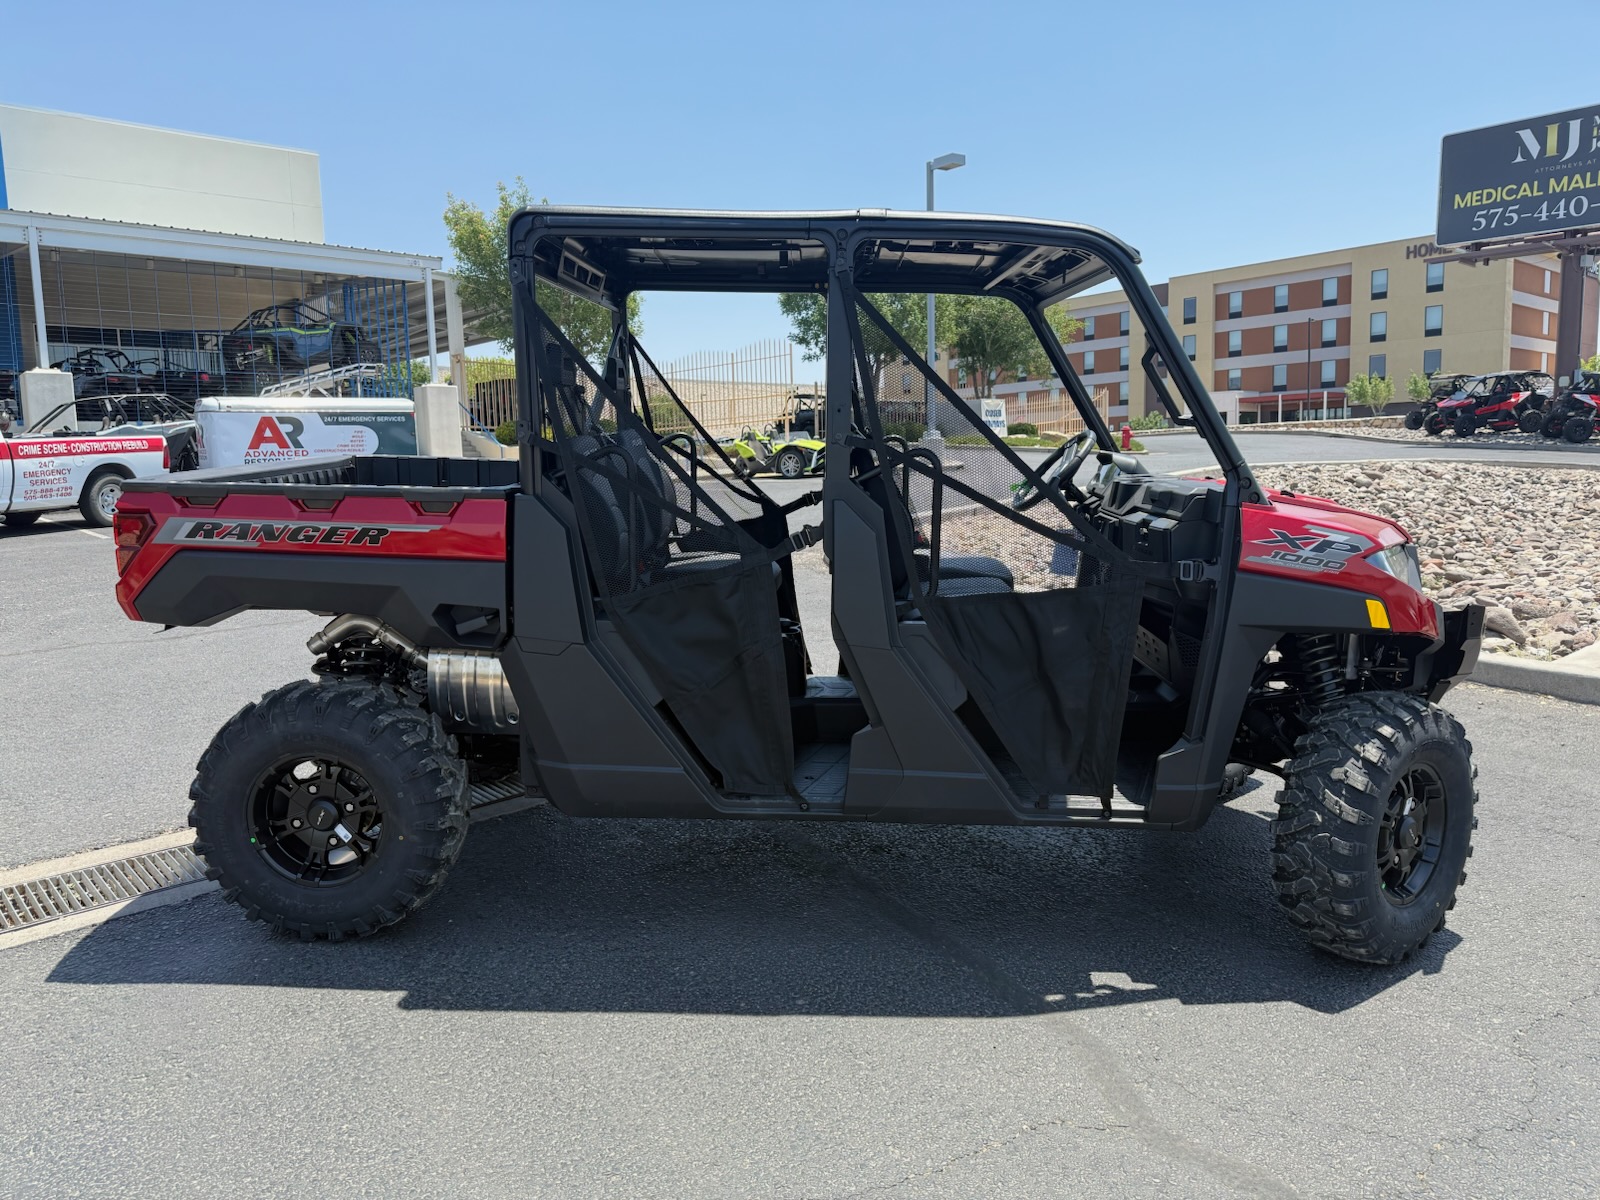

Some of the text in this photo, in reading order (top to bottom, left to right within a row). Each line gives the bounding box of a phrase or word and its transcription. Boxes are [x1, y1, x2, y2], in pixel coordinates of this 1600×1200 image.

[1535, 160, 1583, 174] ATTORNEYS
[1453, 170, 1600, 209] MEDICAL MAL
[247, 416, 305, 449] AR
[18, 444, 42, 456] CRIME
[121, 439, 149, 450] REBUILD
[244, 449, 309, 458] ADVANCED
[38, 460, 55, 468] 24/7
[23, 468, 72, 479] EMERGENCY
[29, 476, 68, 487] SERVICES
[184, 520, 390, 546] RANGER
[1249, 528, 1364, 554] XP
[1267, 549, 1347, 571] 1000
